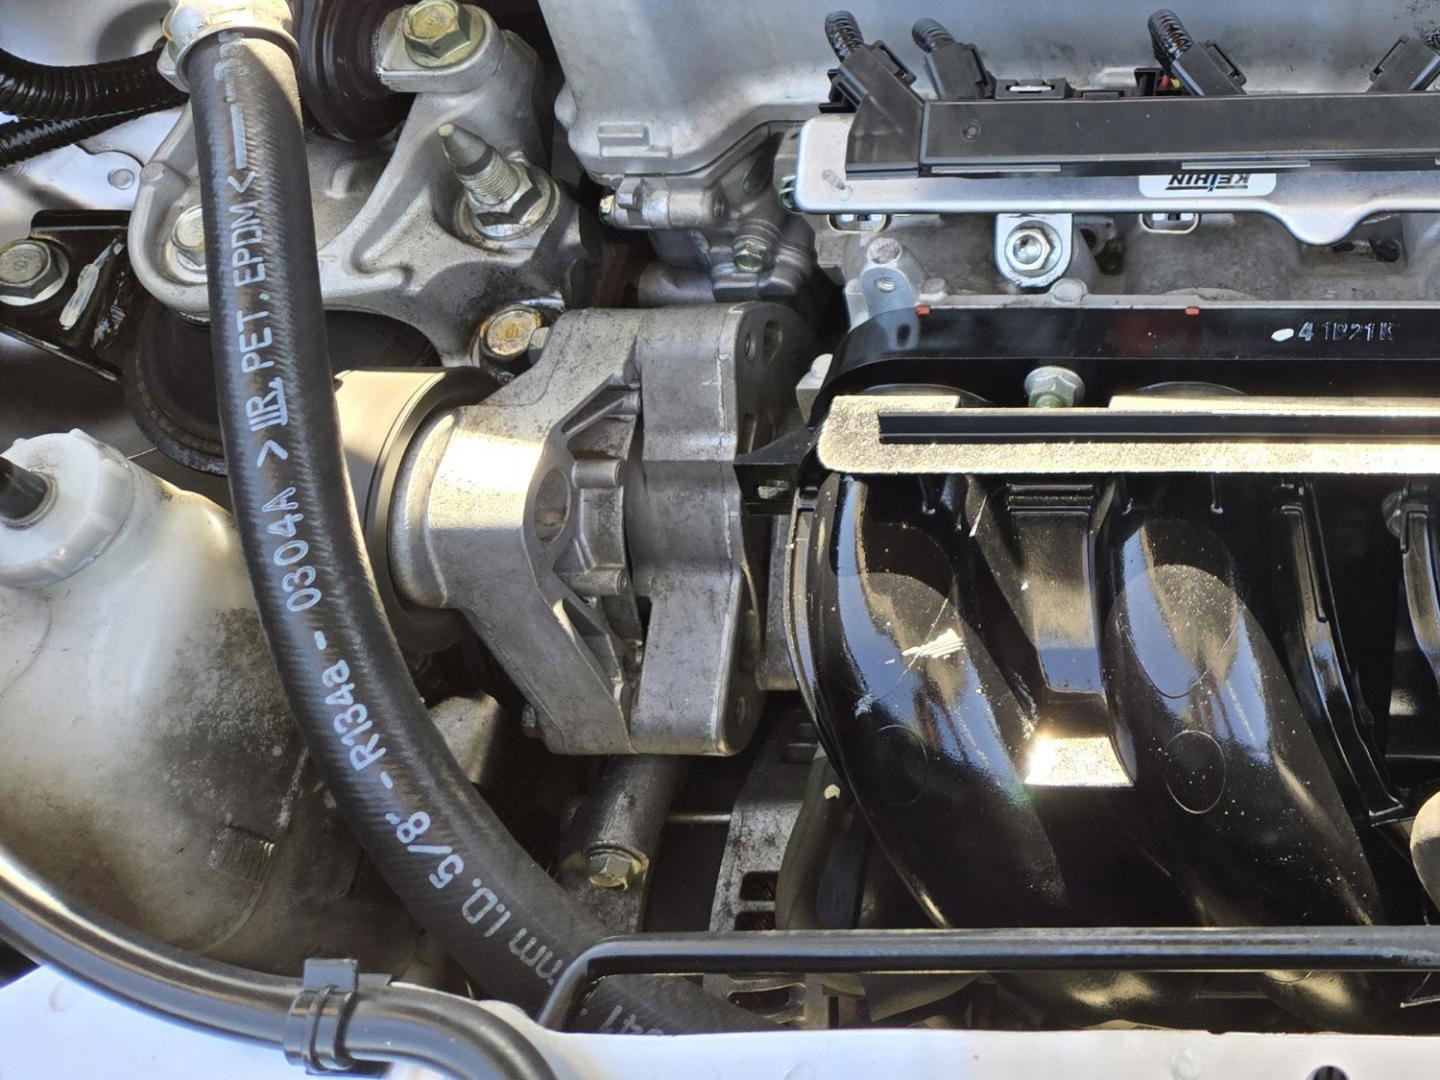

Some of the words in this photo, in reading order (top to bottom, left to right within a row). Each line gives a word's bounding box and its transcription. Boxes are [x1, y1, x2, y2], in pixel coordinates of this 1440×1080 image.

[1166, 173, 1250, 190] KEIHIN
[262, 486, 322, 612] 0304A
[321, 659, 387, 771] R134a
[462, 878, 512, 938] I.D.
